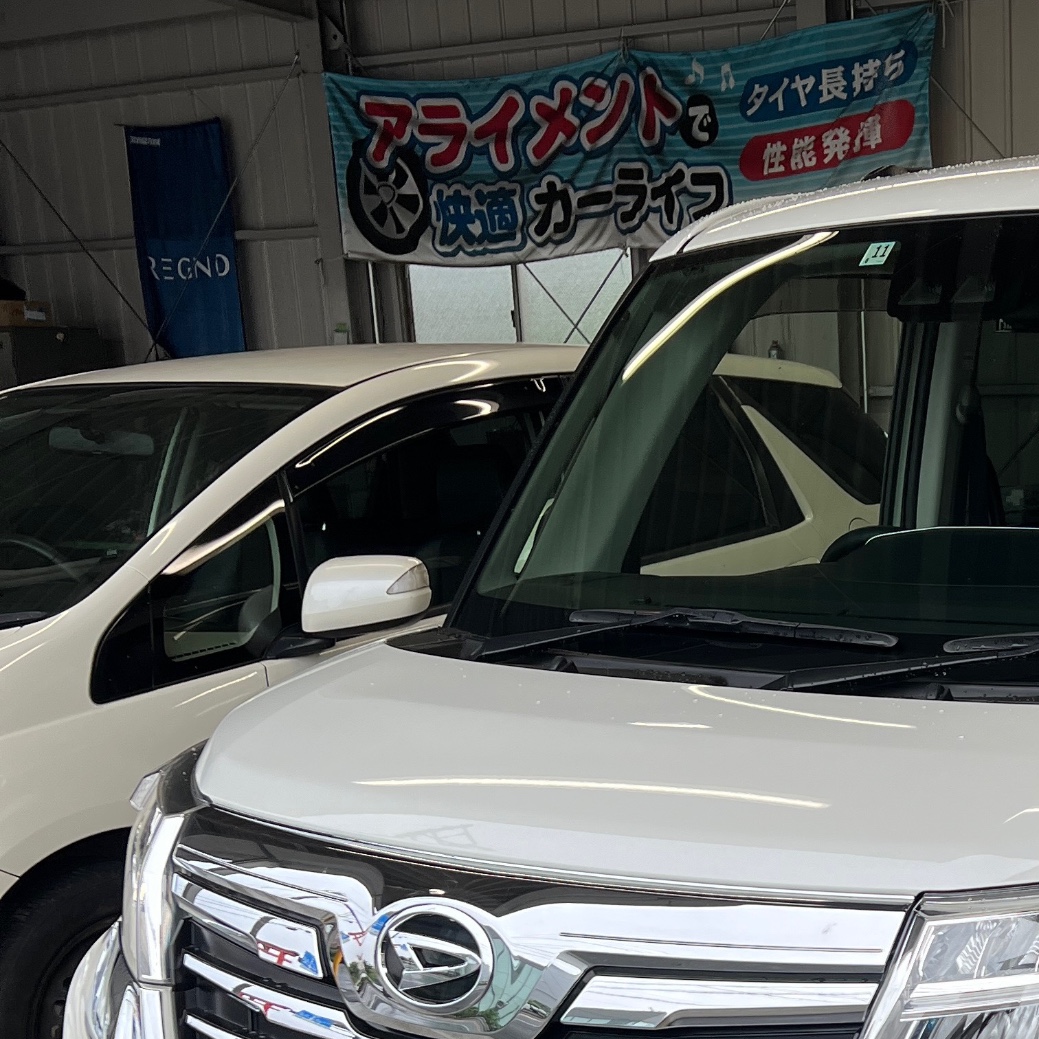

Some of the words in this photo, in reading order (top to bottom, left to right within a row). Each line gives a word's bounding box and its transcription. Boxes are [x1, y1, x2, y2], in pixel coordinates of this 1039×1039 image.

[746, 49, 906, 117] タイヤ長持ち
[362, 70, 712, 170] アライメントで
[763, 113, 883, 177] 性能発揮
[871, 244, 890, 258] 11
